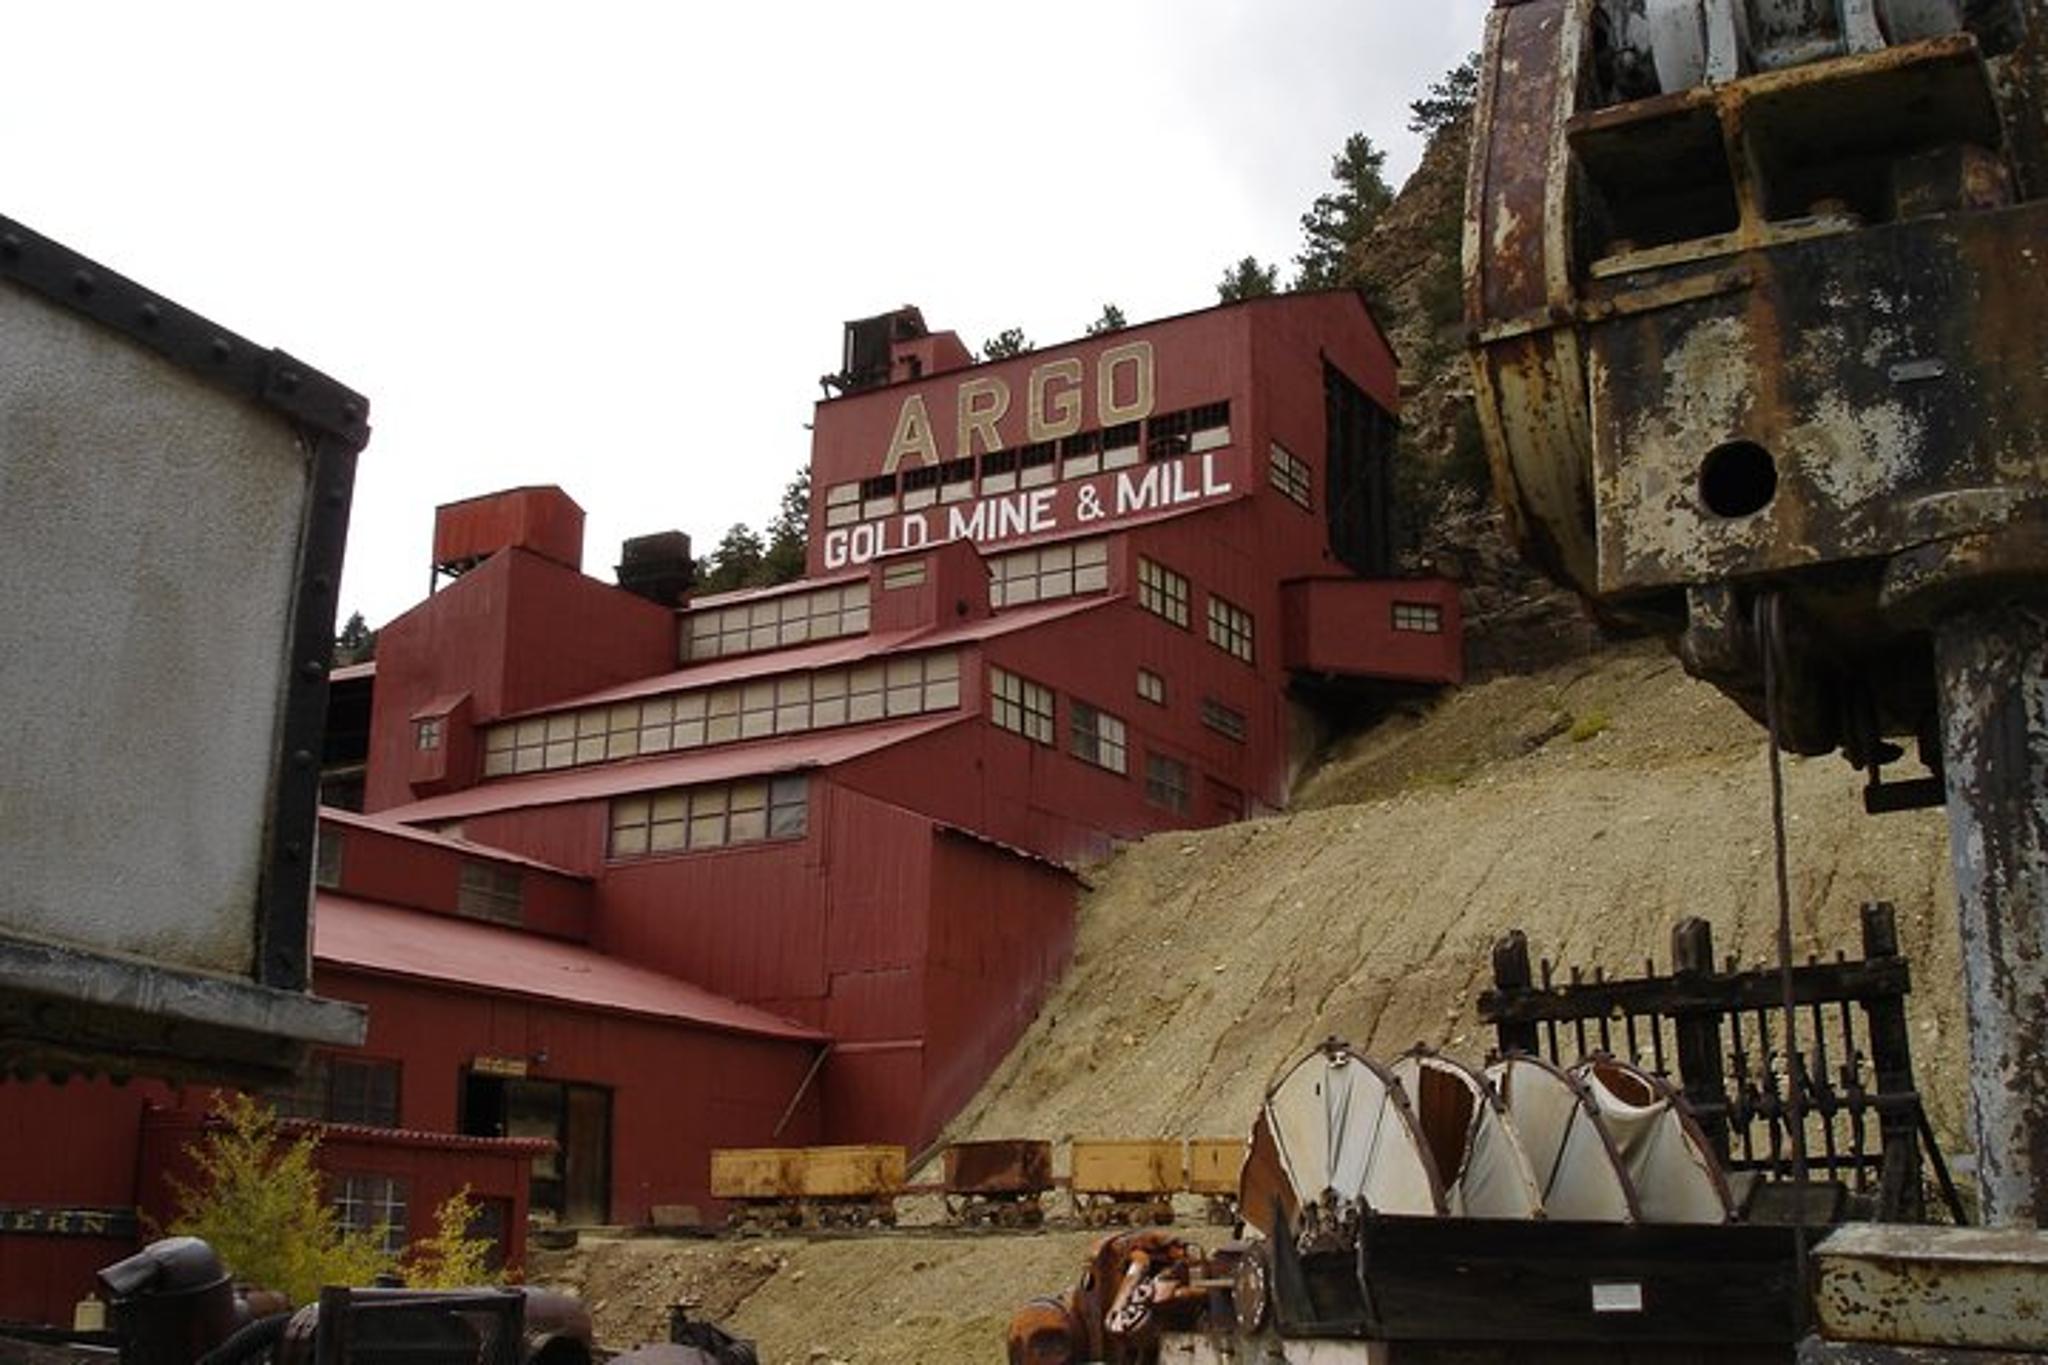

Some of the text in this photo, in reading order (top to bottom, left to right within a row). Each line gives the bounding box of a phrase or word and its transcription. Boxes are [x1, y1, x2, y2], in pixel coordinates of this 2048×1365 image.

[881, 341, 1155, 475] ARGO
[824, 454, 1231, 569] GOLD MINE & MILL
